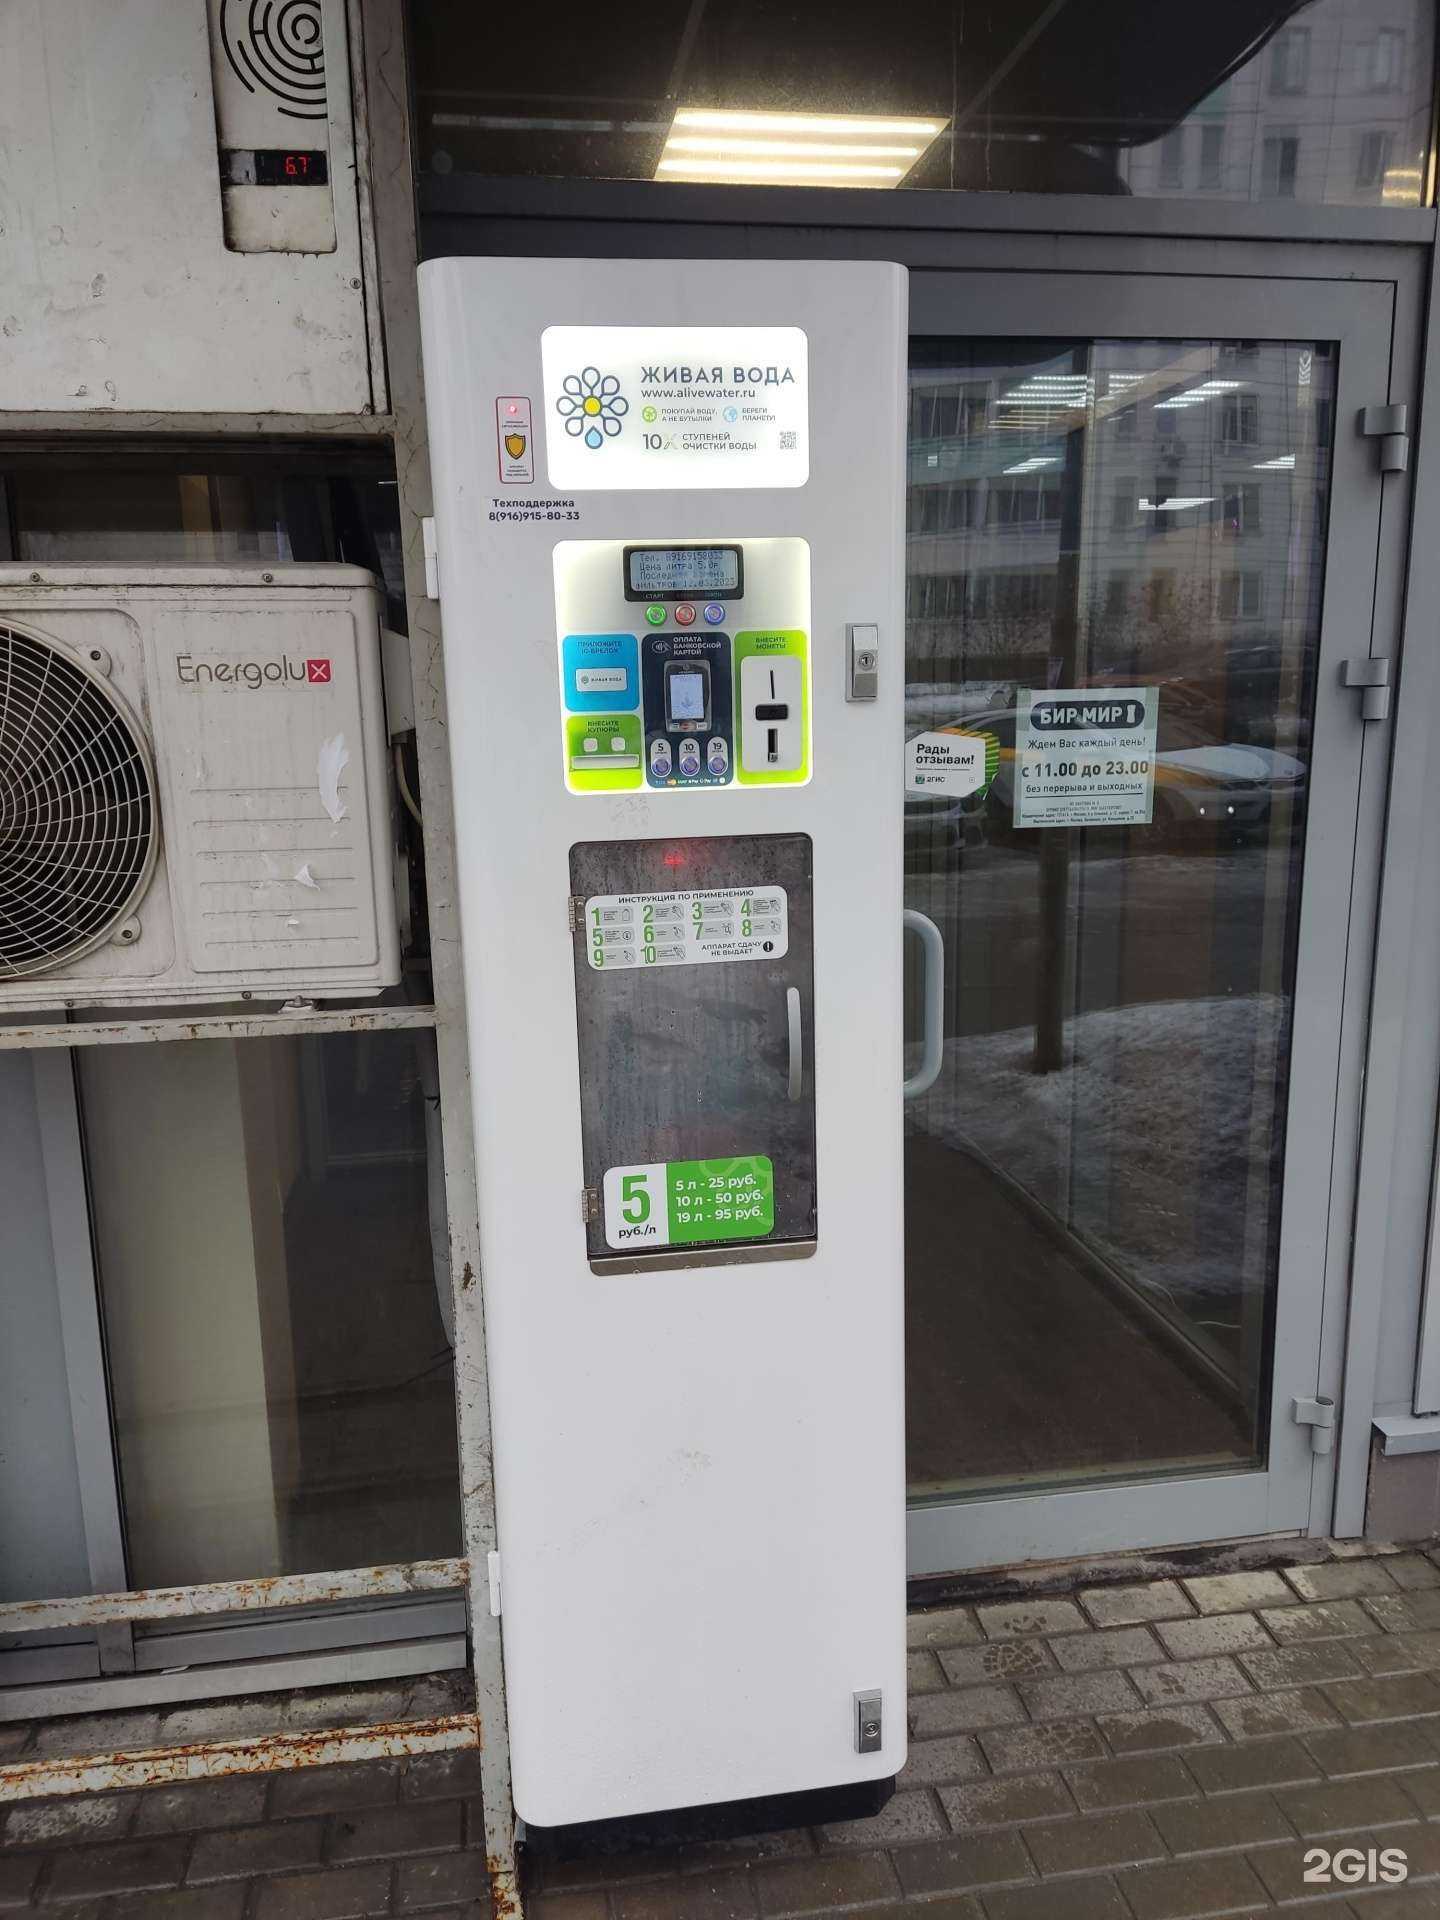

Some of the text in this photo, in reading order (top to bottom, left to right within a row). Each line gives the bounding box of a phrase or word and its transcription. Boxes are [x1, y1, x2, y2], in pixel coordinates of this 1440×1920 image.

[640, 366, 795, 386] ЖИВАЯ ВОДА
[640, 387, 756, 399] www.alivewater.ru
[682, 432, 731, 441] СТУПЕНЕЙ
[682, 442, 757, 450] ОЧИСТКИ ВОДЫ
[492, 499, 575, 509] Техподдержка
[488, 511, 580, 522] 8(916)915-80-33
[176, 655, 331, 690] Energolux
[1040, 706, 1123, 724] БИР МИР
[658, 743, 664, 751] 5
[685, 743, 694, 751] 10
[713, 742, 722, 750] 19
[916, 743, 950, 756] Рады
[1028, 736, 1146, 750] Ждем Вас каждый день!
[915, 754, 975, 765] отзывам!
[1022, 760, 1149, 778] с 11.00 до 23.00
[1026, 784, 1042, 793] без
[1043, 784, 1087, 795] перерыва
[1097, 782, 1143, 792] выходных
[618, 889, 754, 904] ИНСТРУКЦИЯ ПО ПРИМЕНЕНИЮ
[642, 905, 654, 923] 2
[691, 902, 703, 920] 3
[740, 898, 752, 917] 4
[591, 907, 601, 926] 1
[643, 925, 654, 943] 6
[692, 922, 704, 940] 7
[741, 919, 752, 937] 8
[592, 928, 604, 946] 5
[640, 945, 656, 964] 10
[701, 941, 762, 951] АППАРАТ СДАЧУ
[593, 949, 604, 967] 9
[675, 1180, 684, 1191] 5
[687, 1181, 697, 1191] л
[708, 1176, 725, 1189] 25
[728, 1174, 757, 1190] руб.
[622, 1174, 651, 1224] 5
[676, 1196, 690, 1207] 10
[693, 1196, 703, 1206] л
[715, 1192, 732, 1204] 50
[735, 1189, 764, 1205] руб.
[676, 1212, 691, 1223] 19
[693, 1212, 703, 1222] л
[715, 1208, 732, 1220] 95
[735, 1206, 764, 1220] руб.
[618, 1224, 657, 1239] руб./л
